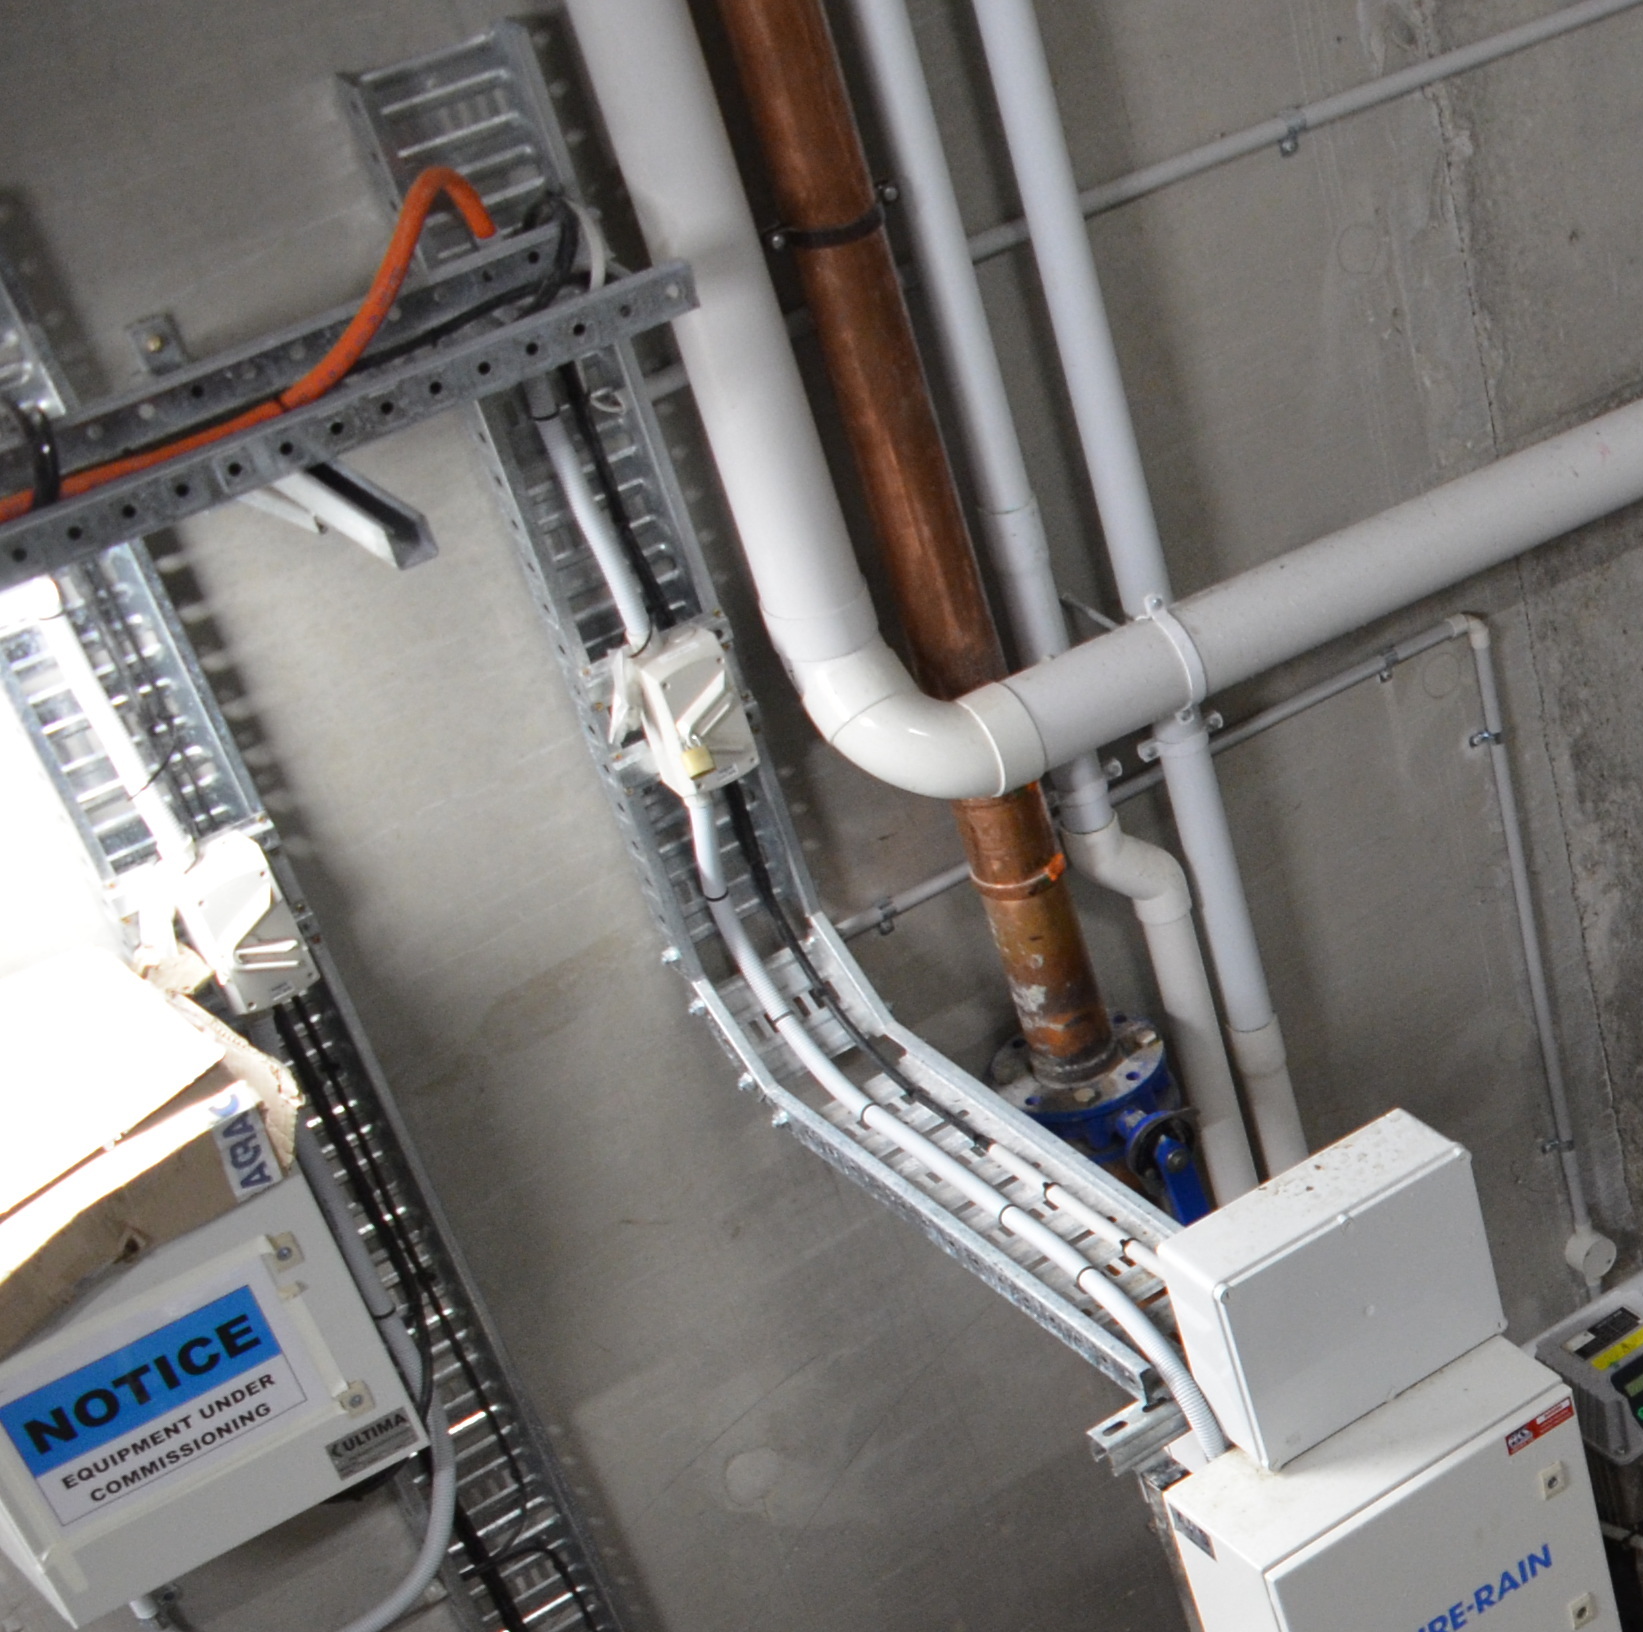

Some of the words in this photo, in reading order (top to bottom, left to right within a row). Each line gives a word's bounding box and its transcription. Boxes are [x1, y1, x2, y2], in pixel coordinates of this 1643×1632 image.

[23, 1313, 263, 1456] NOTICE
[61, 1415, 192, 1490] EQUIPMENT
[199, 1373, 276, 1420] UNDER
[342, 1413, 407, 1452] ULTIMA
[90, 1402, 273, 1503] COMMISSIONING
